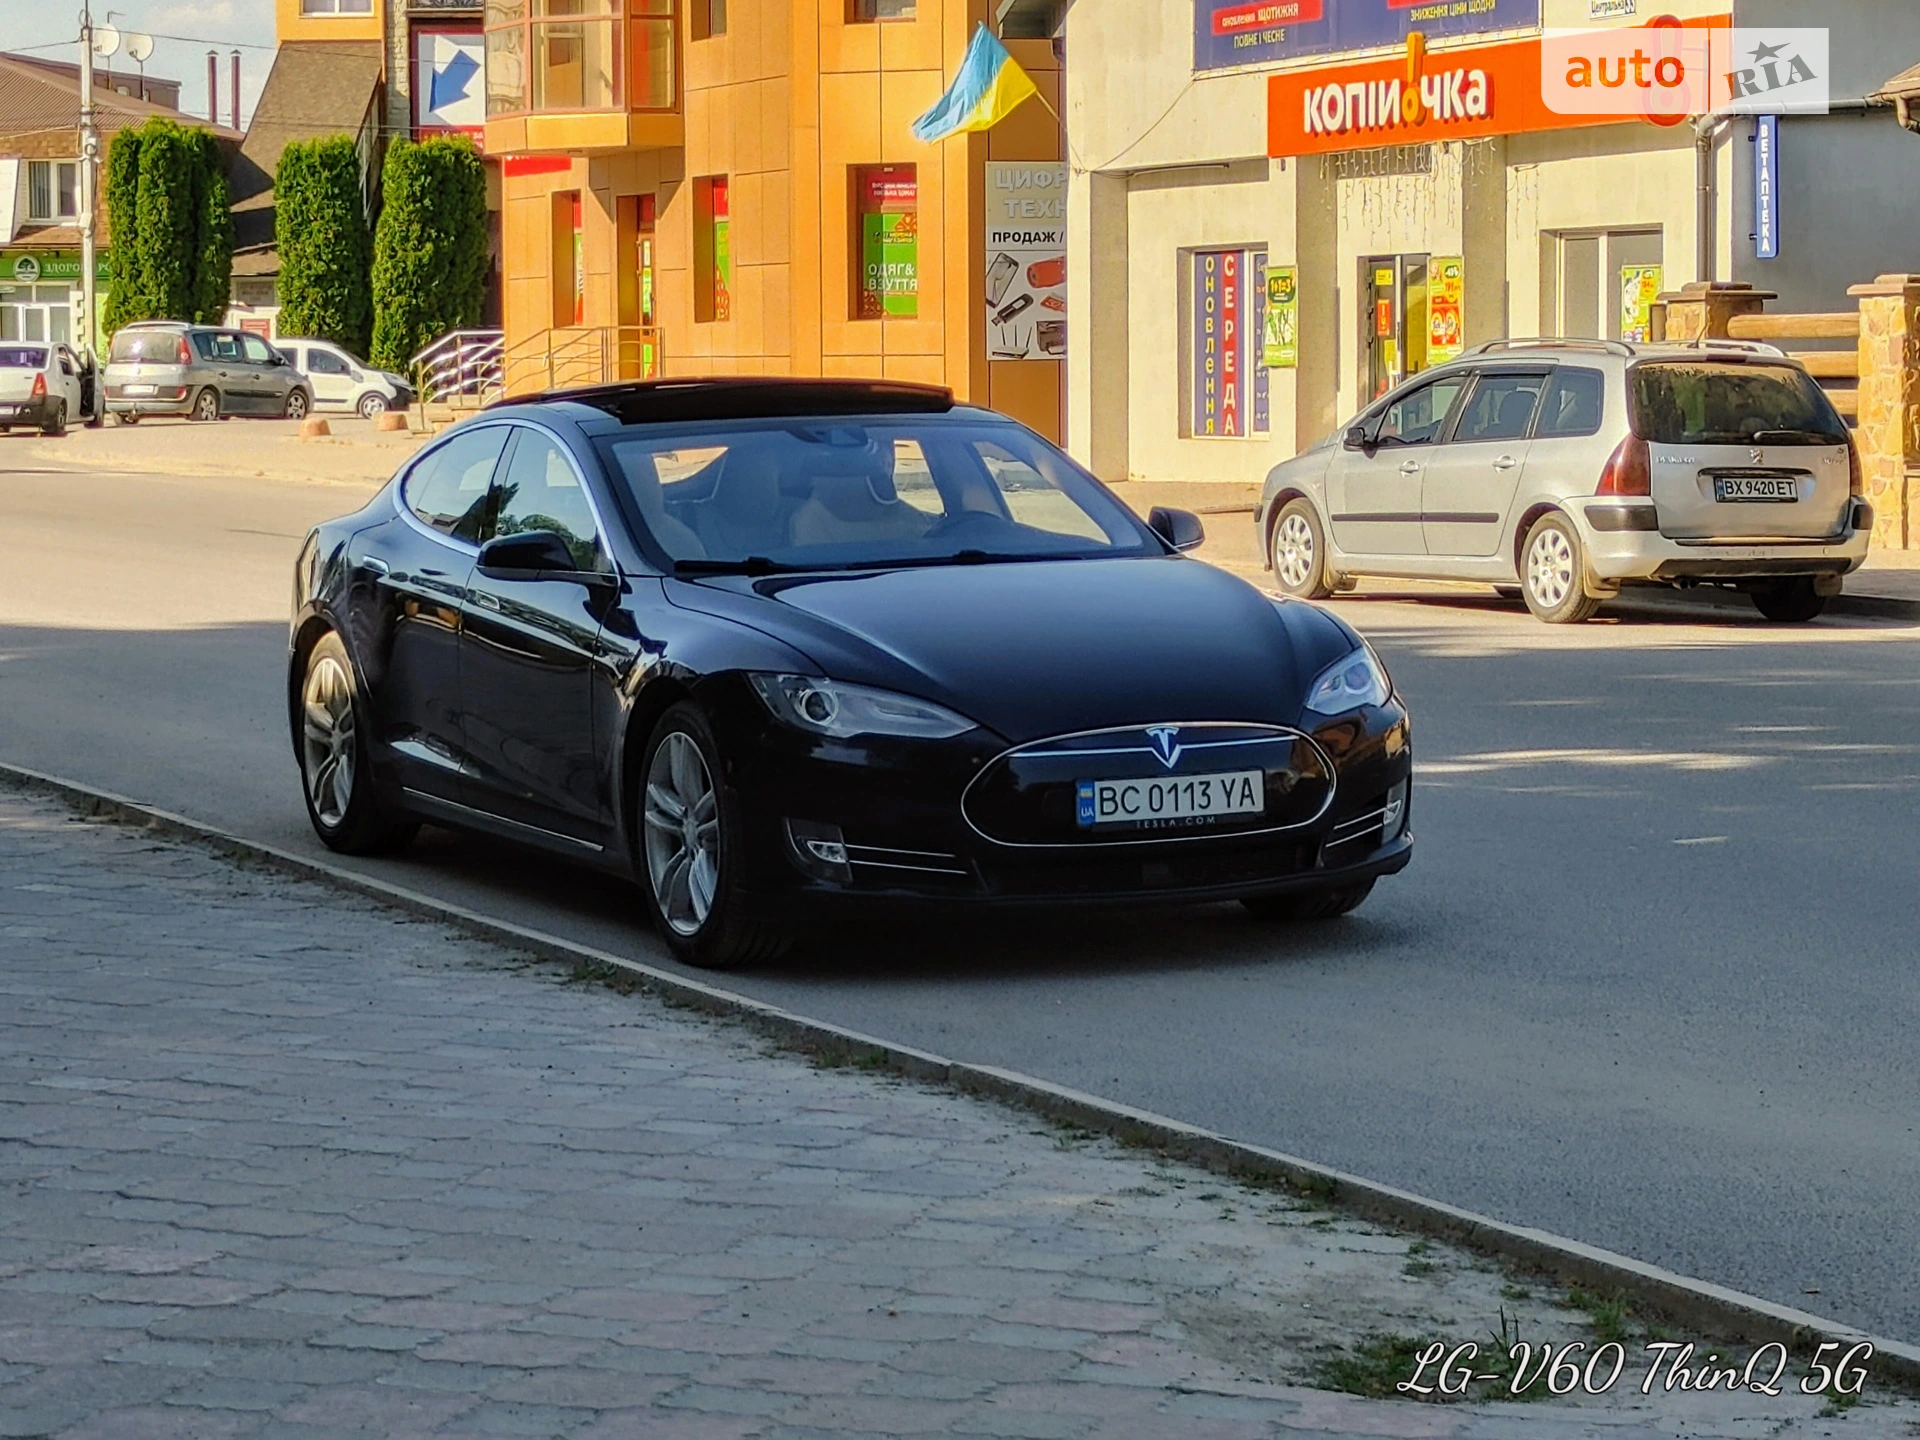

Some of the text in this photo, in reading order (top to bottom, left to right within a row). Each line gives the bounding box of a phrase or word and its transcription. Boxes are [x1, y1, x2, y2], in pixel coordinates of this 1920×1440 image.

[1258, 3, 1298, 23] ЩОТИЖНЯ
[1410, 8, 1448, 21] ЗНИЖЕННЯ
[1449, 5, 1467, 16] ЦІНИ
[1234, 33, 1258, 48] ПОВНЕ
[1263, 29, 1286, 44] ЧЕСНЕ
[1760, 124, 1770, 252] ВЕТАПТЕКА
[992, 231, 1056, 244] ПРОДАЖ
[868, 263, 914, 278] ОДЯГ&
[868, 278, 918, 290] ВЗУТТЯ
[1223, 255, 1236, 435] СЕРЕДА
[1725, 480, 1794, 495] BX 9420 ET
[1081, 777, 1255, 817] UA BC 0113 YA
[1136, 816, 1216, 828] TESLA.COM
